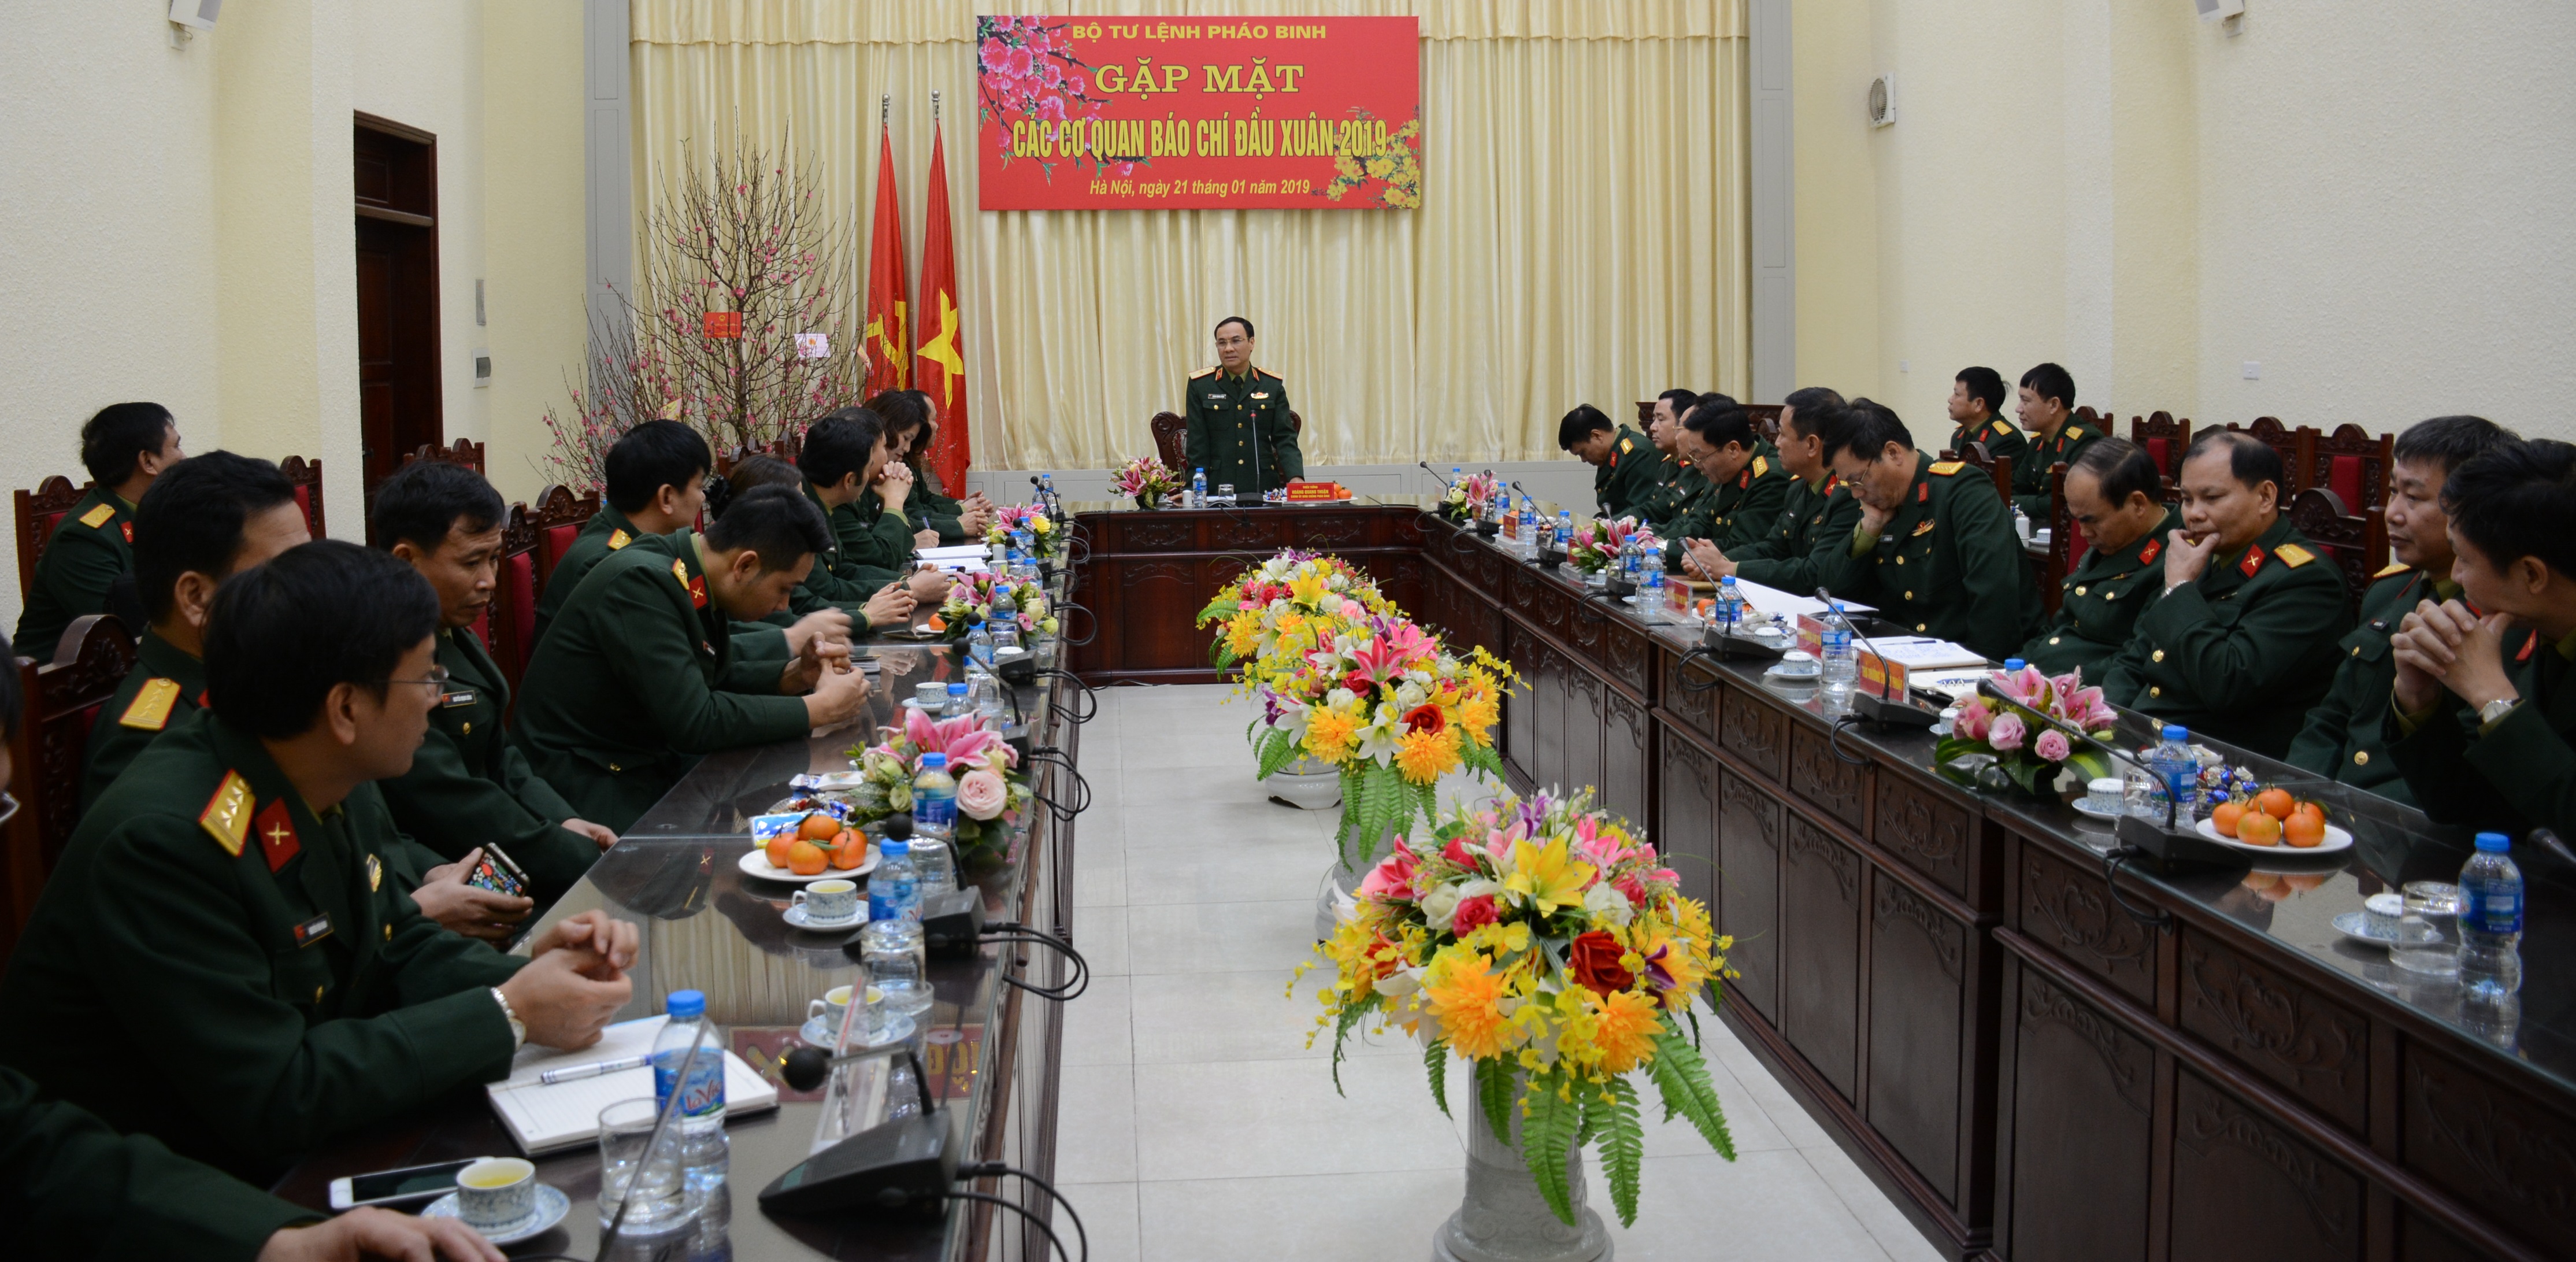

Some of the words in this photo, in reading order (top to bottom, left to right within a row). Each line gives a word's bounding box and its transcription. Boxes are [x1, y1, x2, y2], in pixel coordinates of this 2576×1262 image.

[1073, 23, 1102, 43] BỘ
[1109, 24, 1139, 39] TƯ
[1145, 22, 1200, 43] LỆNH
[1207, 22, 1269, 39] PHÁO
[1276, 25, 1326, 39] BINH
[1095, 56, 1189, 101] GẶP
[1202, 56, 1304, 101] MẶT
[1013, 112, 1053, 158] CÁC
[1058, 117, 1087, 158] CƠ
[1091, 119, 1145, 162] QUAN
[1151, 111, 1191, 158] BÁO
[1196, 111, 1229, 158] CHÍ
[1234, 106, 1274, 158] ĐẦU
[1280, 111, 1334, 158] XUÂN
[1339, 119, 1387, 158] 2019
[1090, 180, 1107, 194] Hà
[1110, 180, 1135, 198] Nội,
[1139, 180, 1171, 198] ngày
[1173, 180, 1188, 194] 21
[1192, 179, 1228, 198] tháng
[1231, 180, 1246, 194] 01
[1250, 180, 1277, 194] năm
[1280, 180, 1310, 194] 2019
